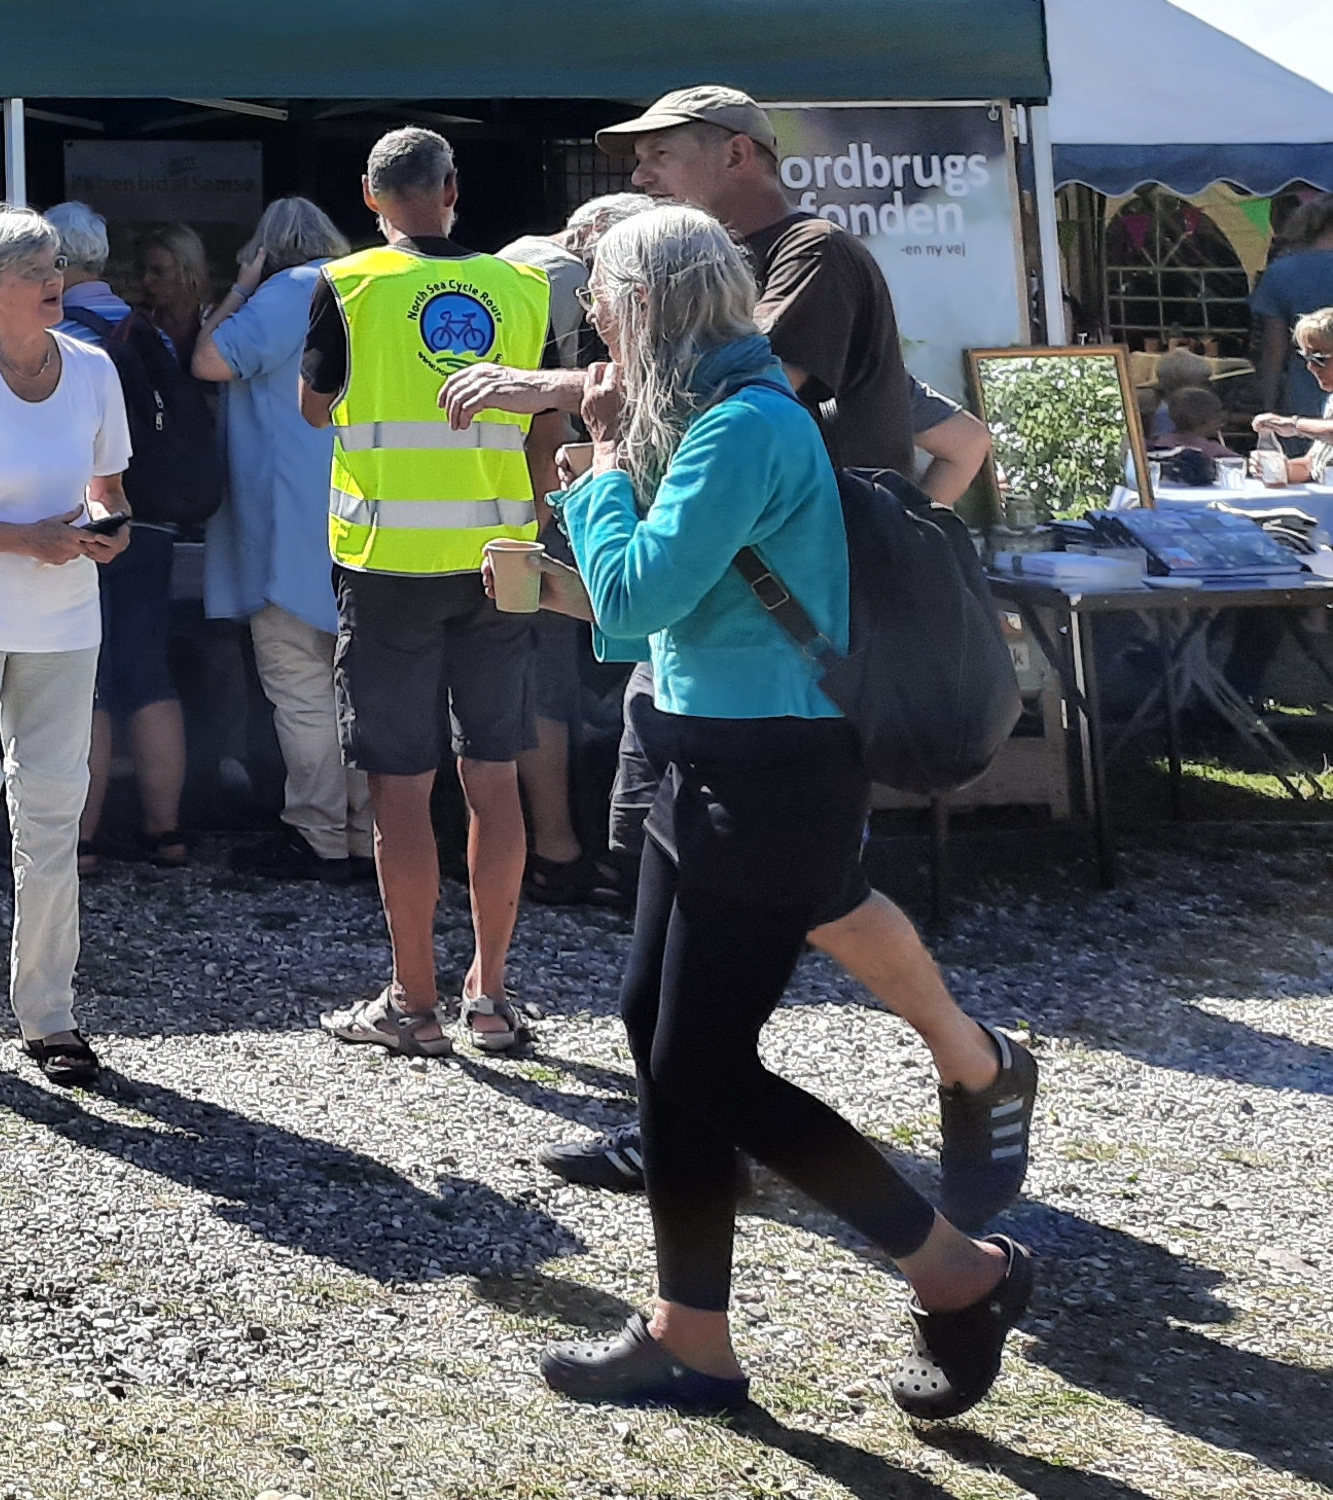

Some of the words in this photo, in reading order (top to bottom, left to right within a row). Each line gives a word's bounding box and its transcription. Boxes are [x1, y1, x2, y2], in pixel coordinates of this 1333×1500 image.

[780, 142, 990, 197] ordbrugs
[927, 244, 942, 257] ny
[407, 291, 429, 321] North
[426, 281, 447, 294] Sea
[449, 279, 479, 293] Cycle
[480, 292, 503, 323] Route
